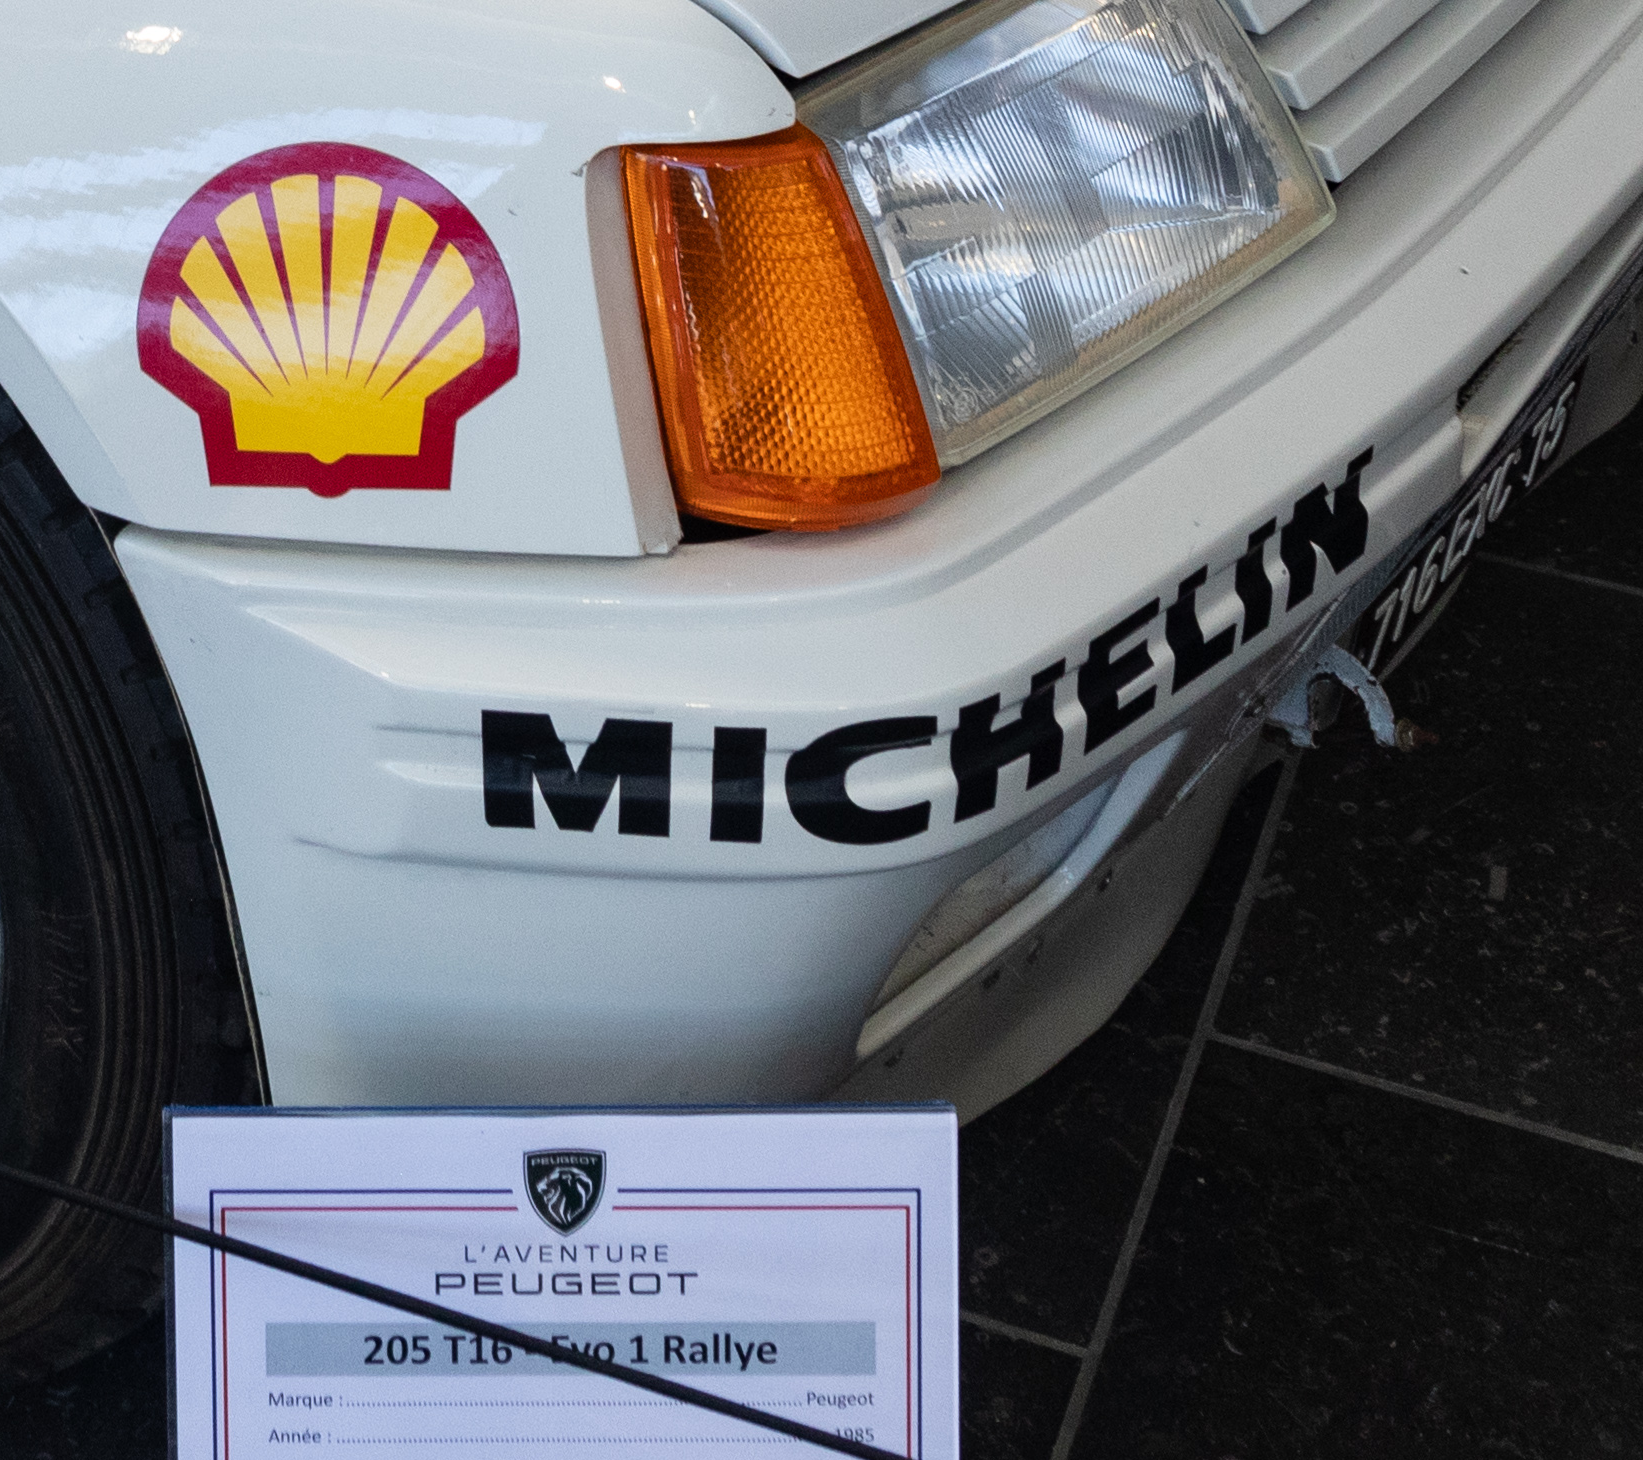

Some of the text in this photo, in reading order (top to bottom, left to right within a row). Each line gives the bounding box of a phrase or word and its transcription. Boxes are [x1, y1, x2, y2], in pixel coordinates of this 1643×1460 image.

[480, 445, 1375, 846] MICHELIN
[530, 1156, 600, 1167] PEUGEOT
[463, 1243, 671, 1264] L'AVENTURE
[434, 1271, 700, 1296] PEUGEOT
[363, 1335, 432, 1365] 205
[443, 1334, 514, 1365] T16
[629, 1335, 649, 1365] 1
[663, 1333, 779, 1372] Rallye
[267, 1390, 875, 1411] Marque Peugeot
[268, 1428, 322, 1444] Année
